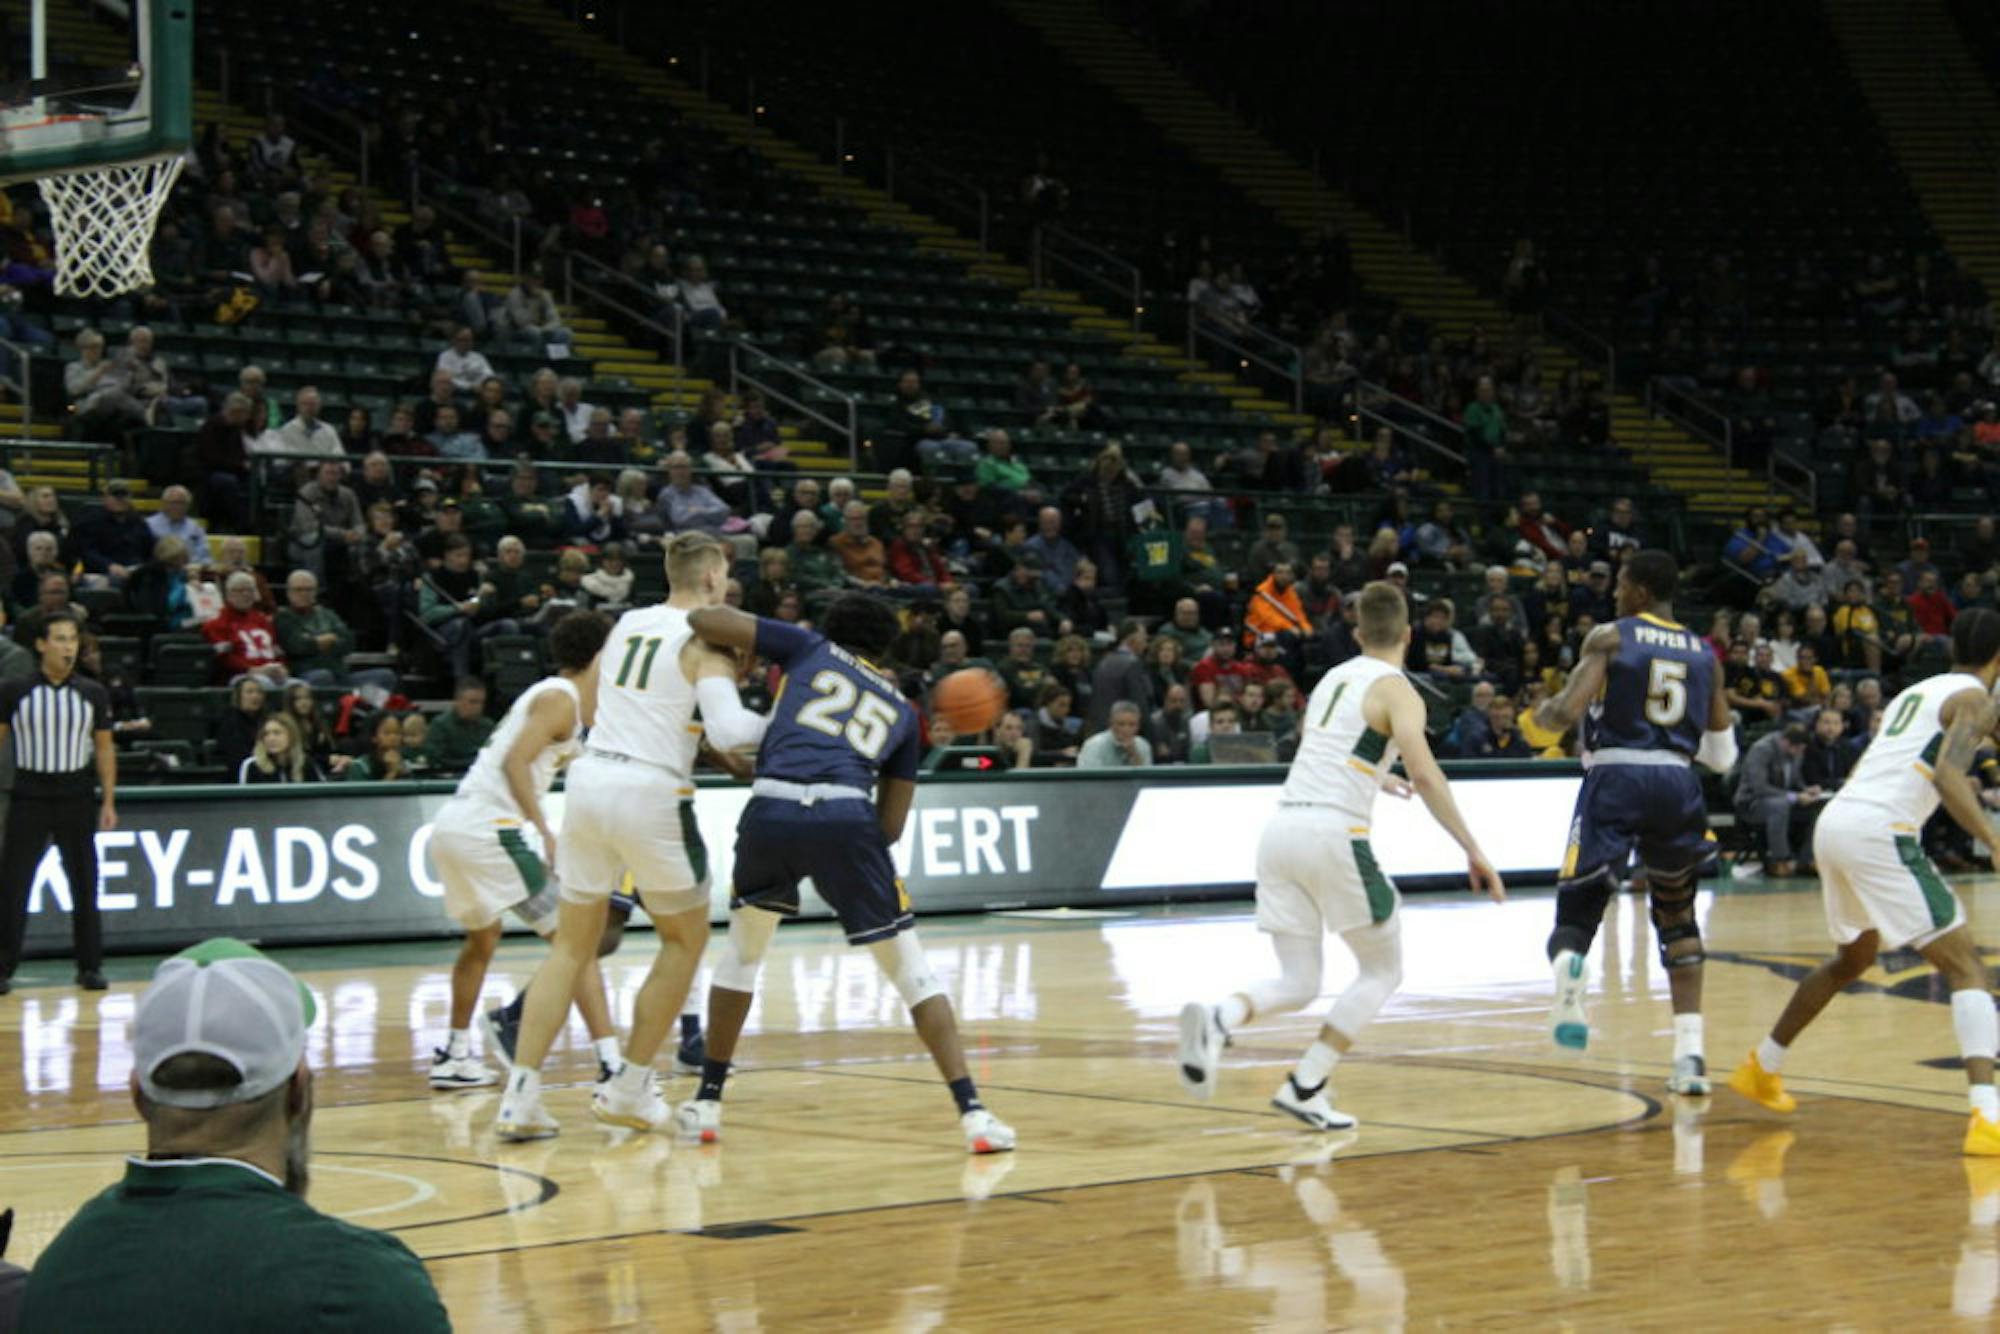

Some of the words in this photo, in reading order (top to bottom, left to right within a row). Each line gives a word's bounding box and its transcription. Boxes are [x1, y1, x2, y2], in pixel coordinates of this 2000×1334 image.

[237, 628, 276, 660] 13
[614, 634, 664, 692] 11
[795, 669, 899, 760] 25
[1317, 679, 1349, 729] 1
[1644, 658, 1688, 727] 5
[1884, 692, 1925, 737] 0
